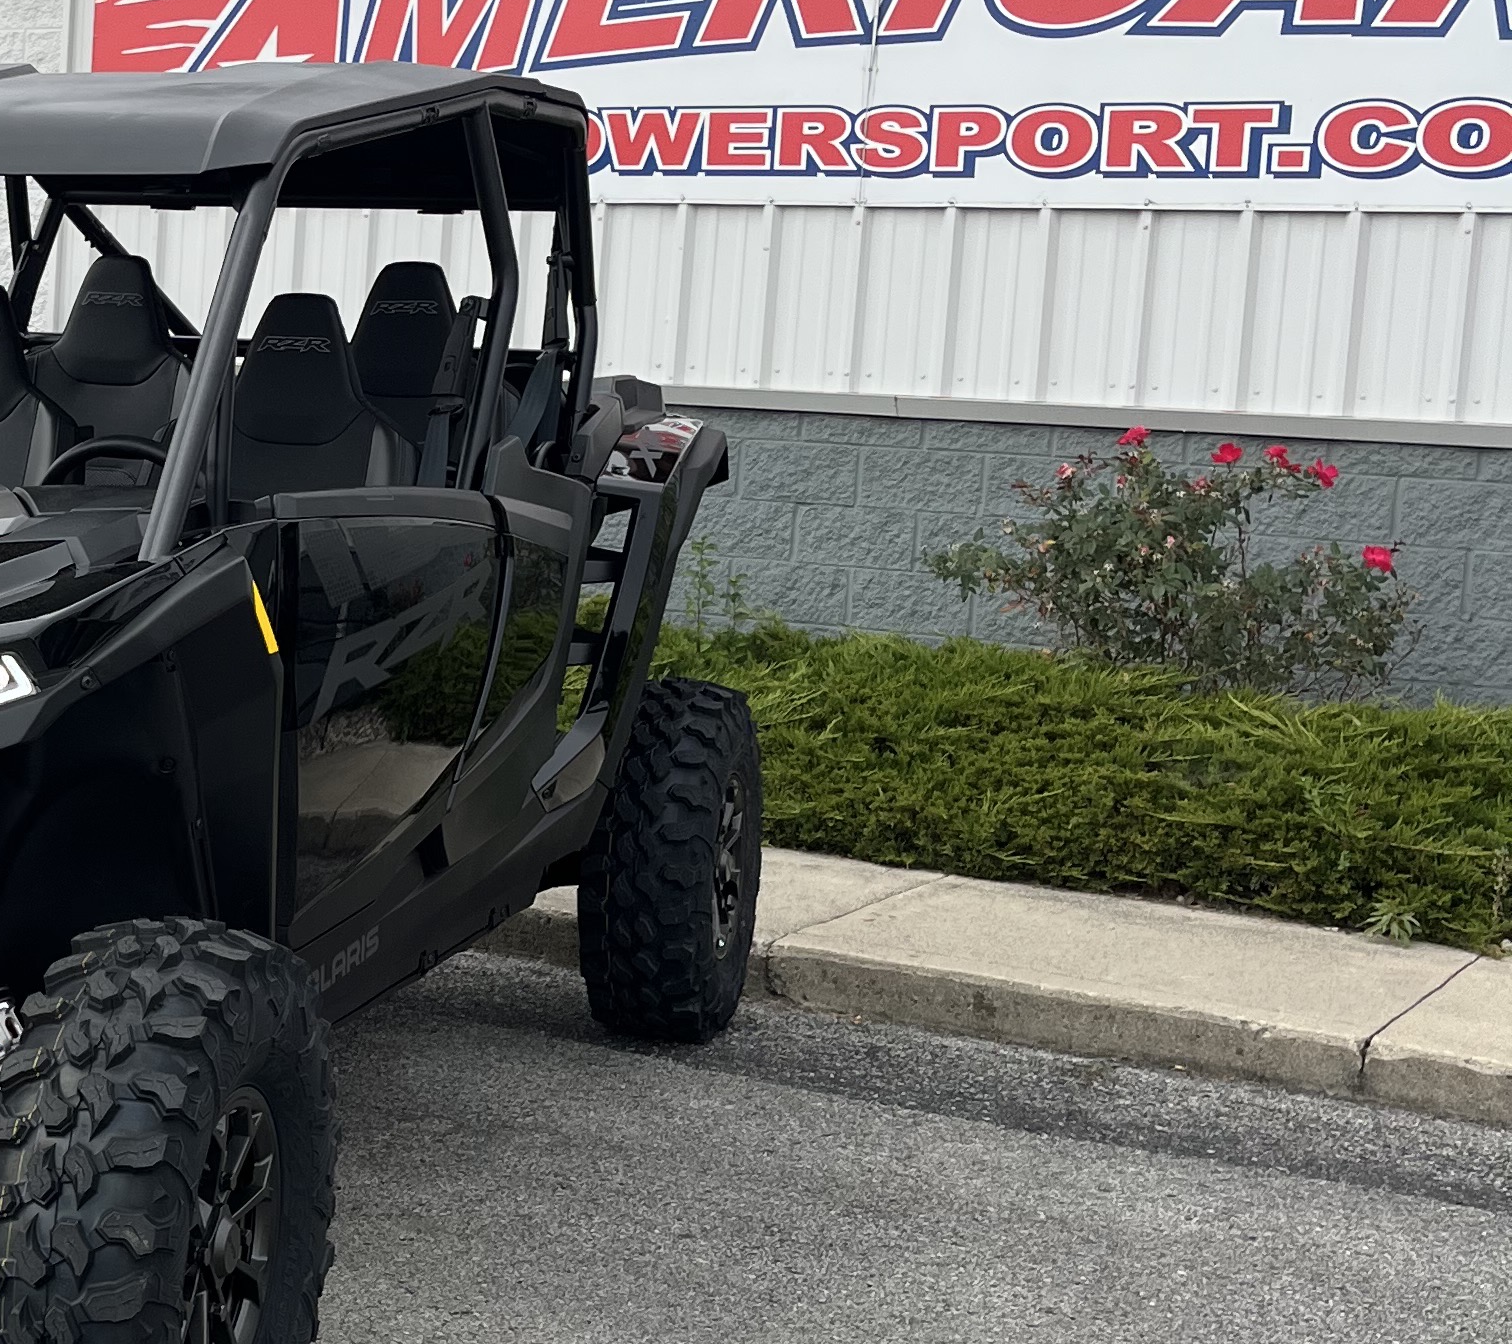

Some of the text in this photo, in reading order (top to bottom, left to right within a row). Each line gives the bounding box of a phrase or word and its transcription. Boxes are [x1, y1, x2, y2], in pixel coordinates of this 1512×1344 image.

[588, 96, 1512, 179] WERSPORT.CO
[81, 290, 144, 309] RZR
[369, 299, 439, 317] RZR
[256, 335, 332, 354] RZR
